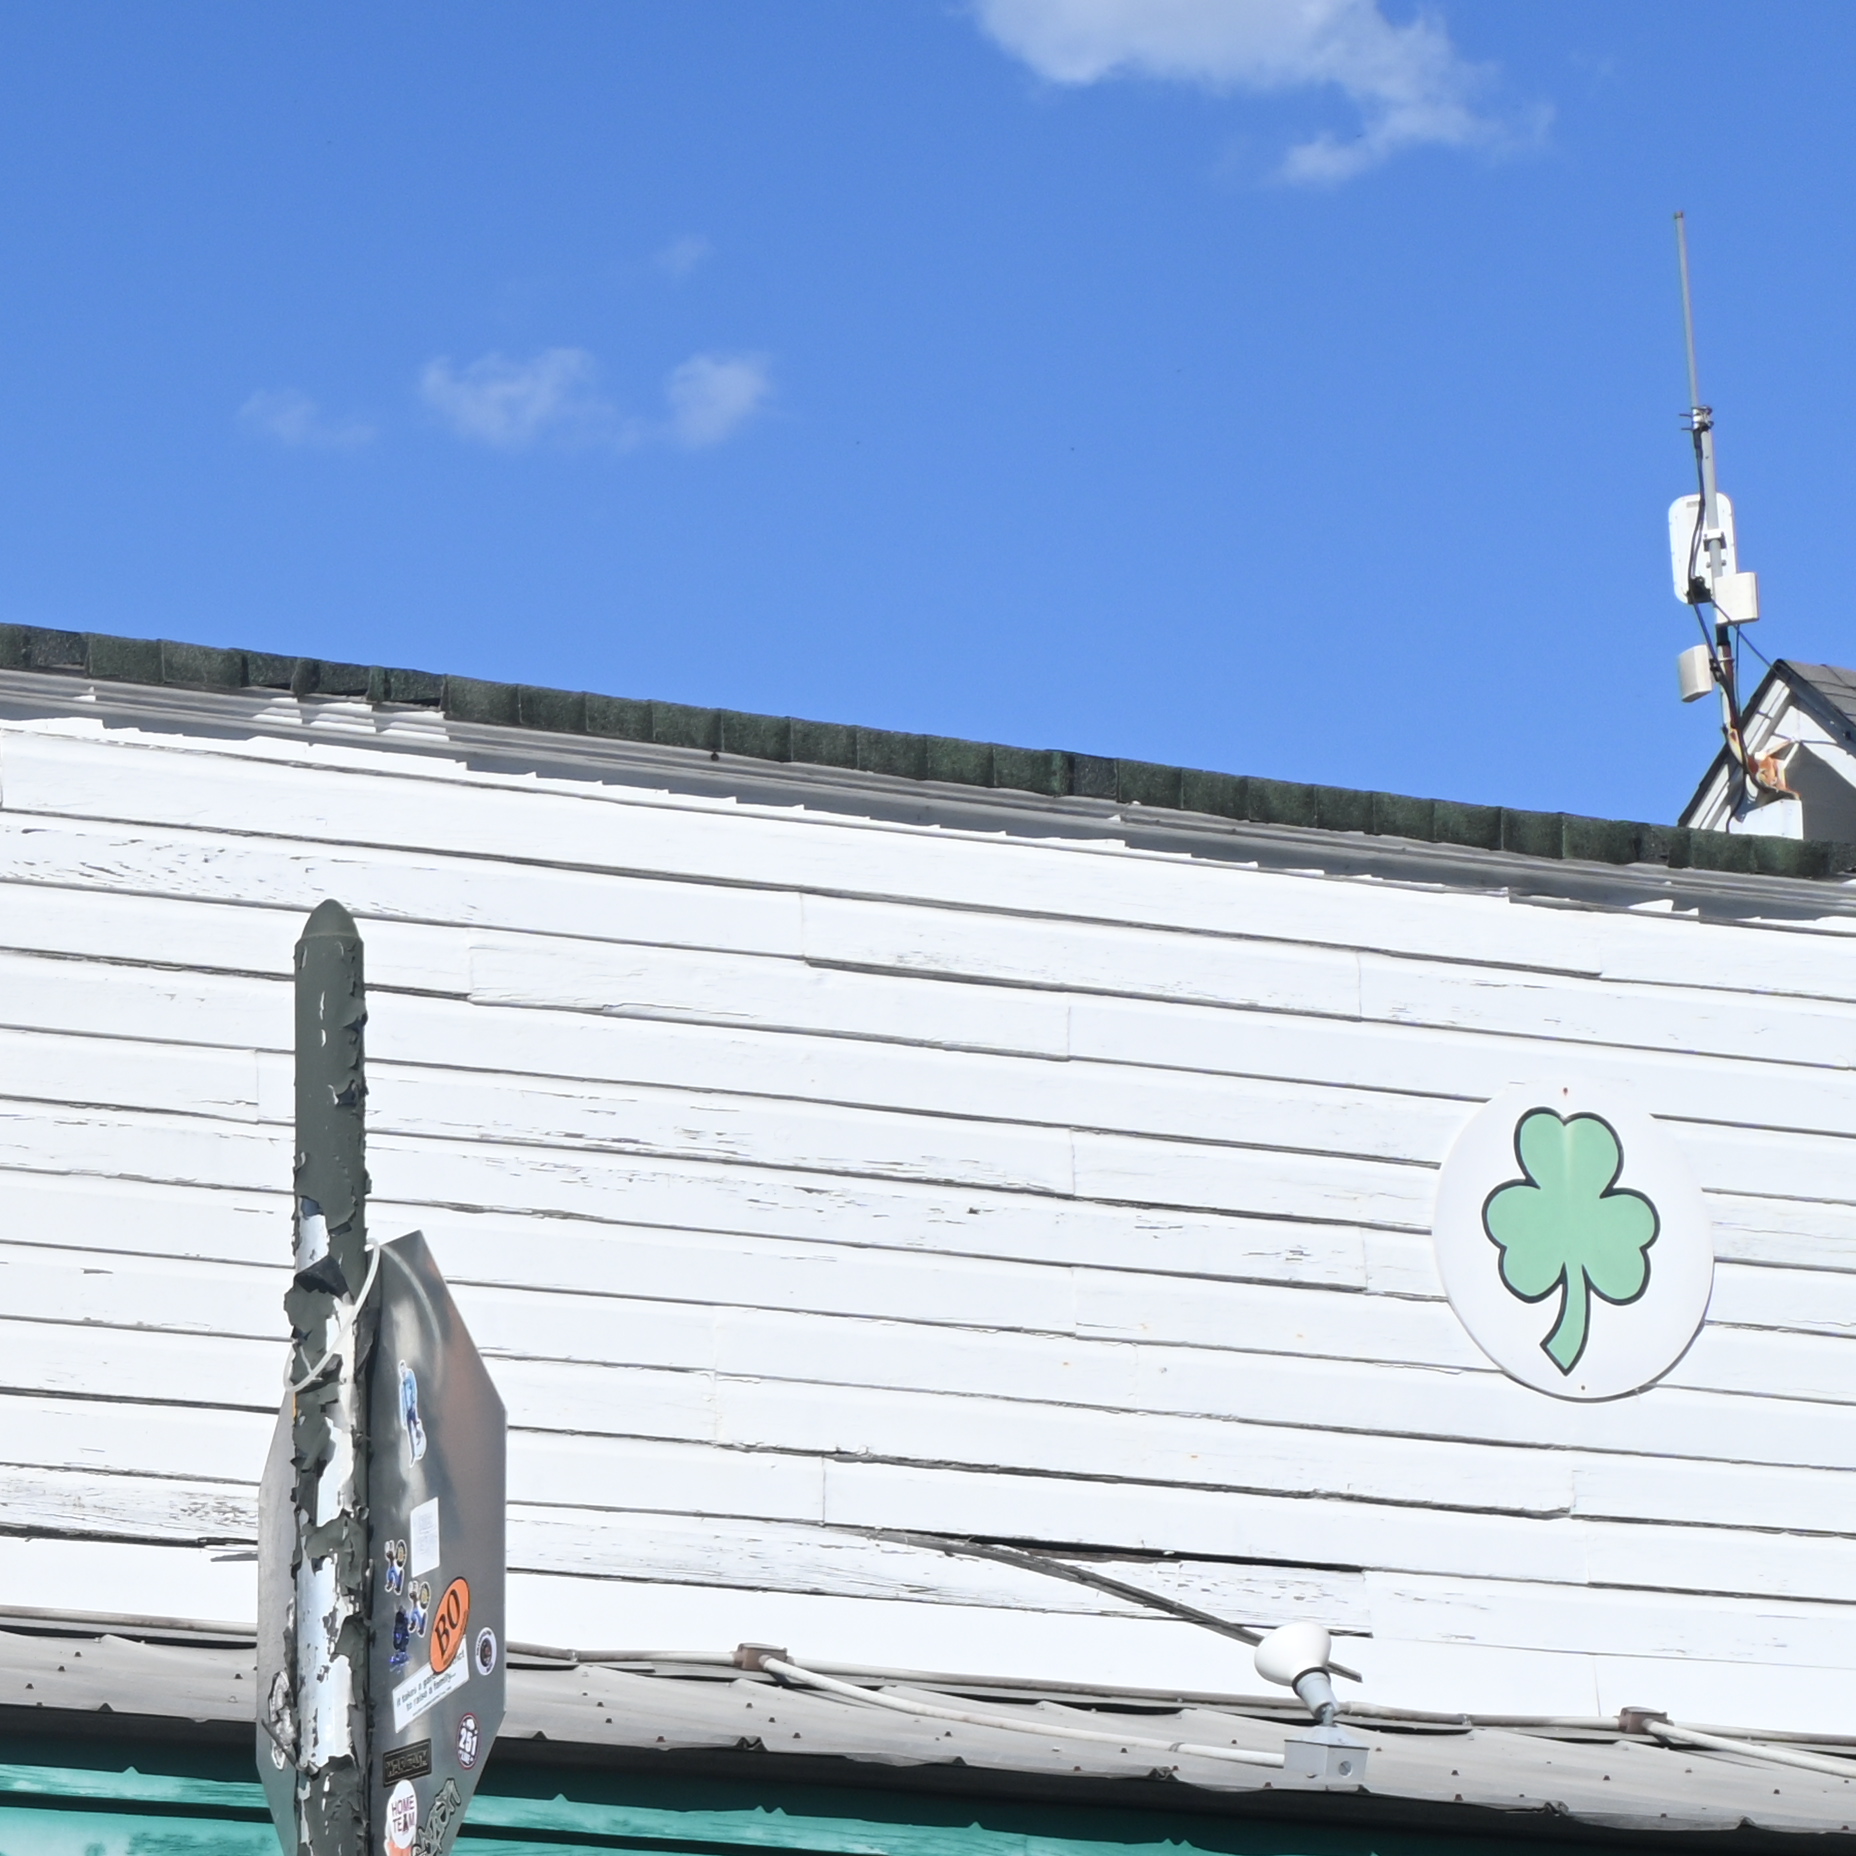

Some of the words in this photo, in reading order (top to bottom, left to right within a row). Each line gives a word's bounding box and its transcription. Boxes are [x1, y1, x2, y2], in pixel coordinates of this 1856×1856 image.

[434, 1588, 461, 1657] BO
[458, 1728, 478, 1757] 251
[391, 1794, 415, 1814] HOME
